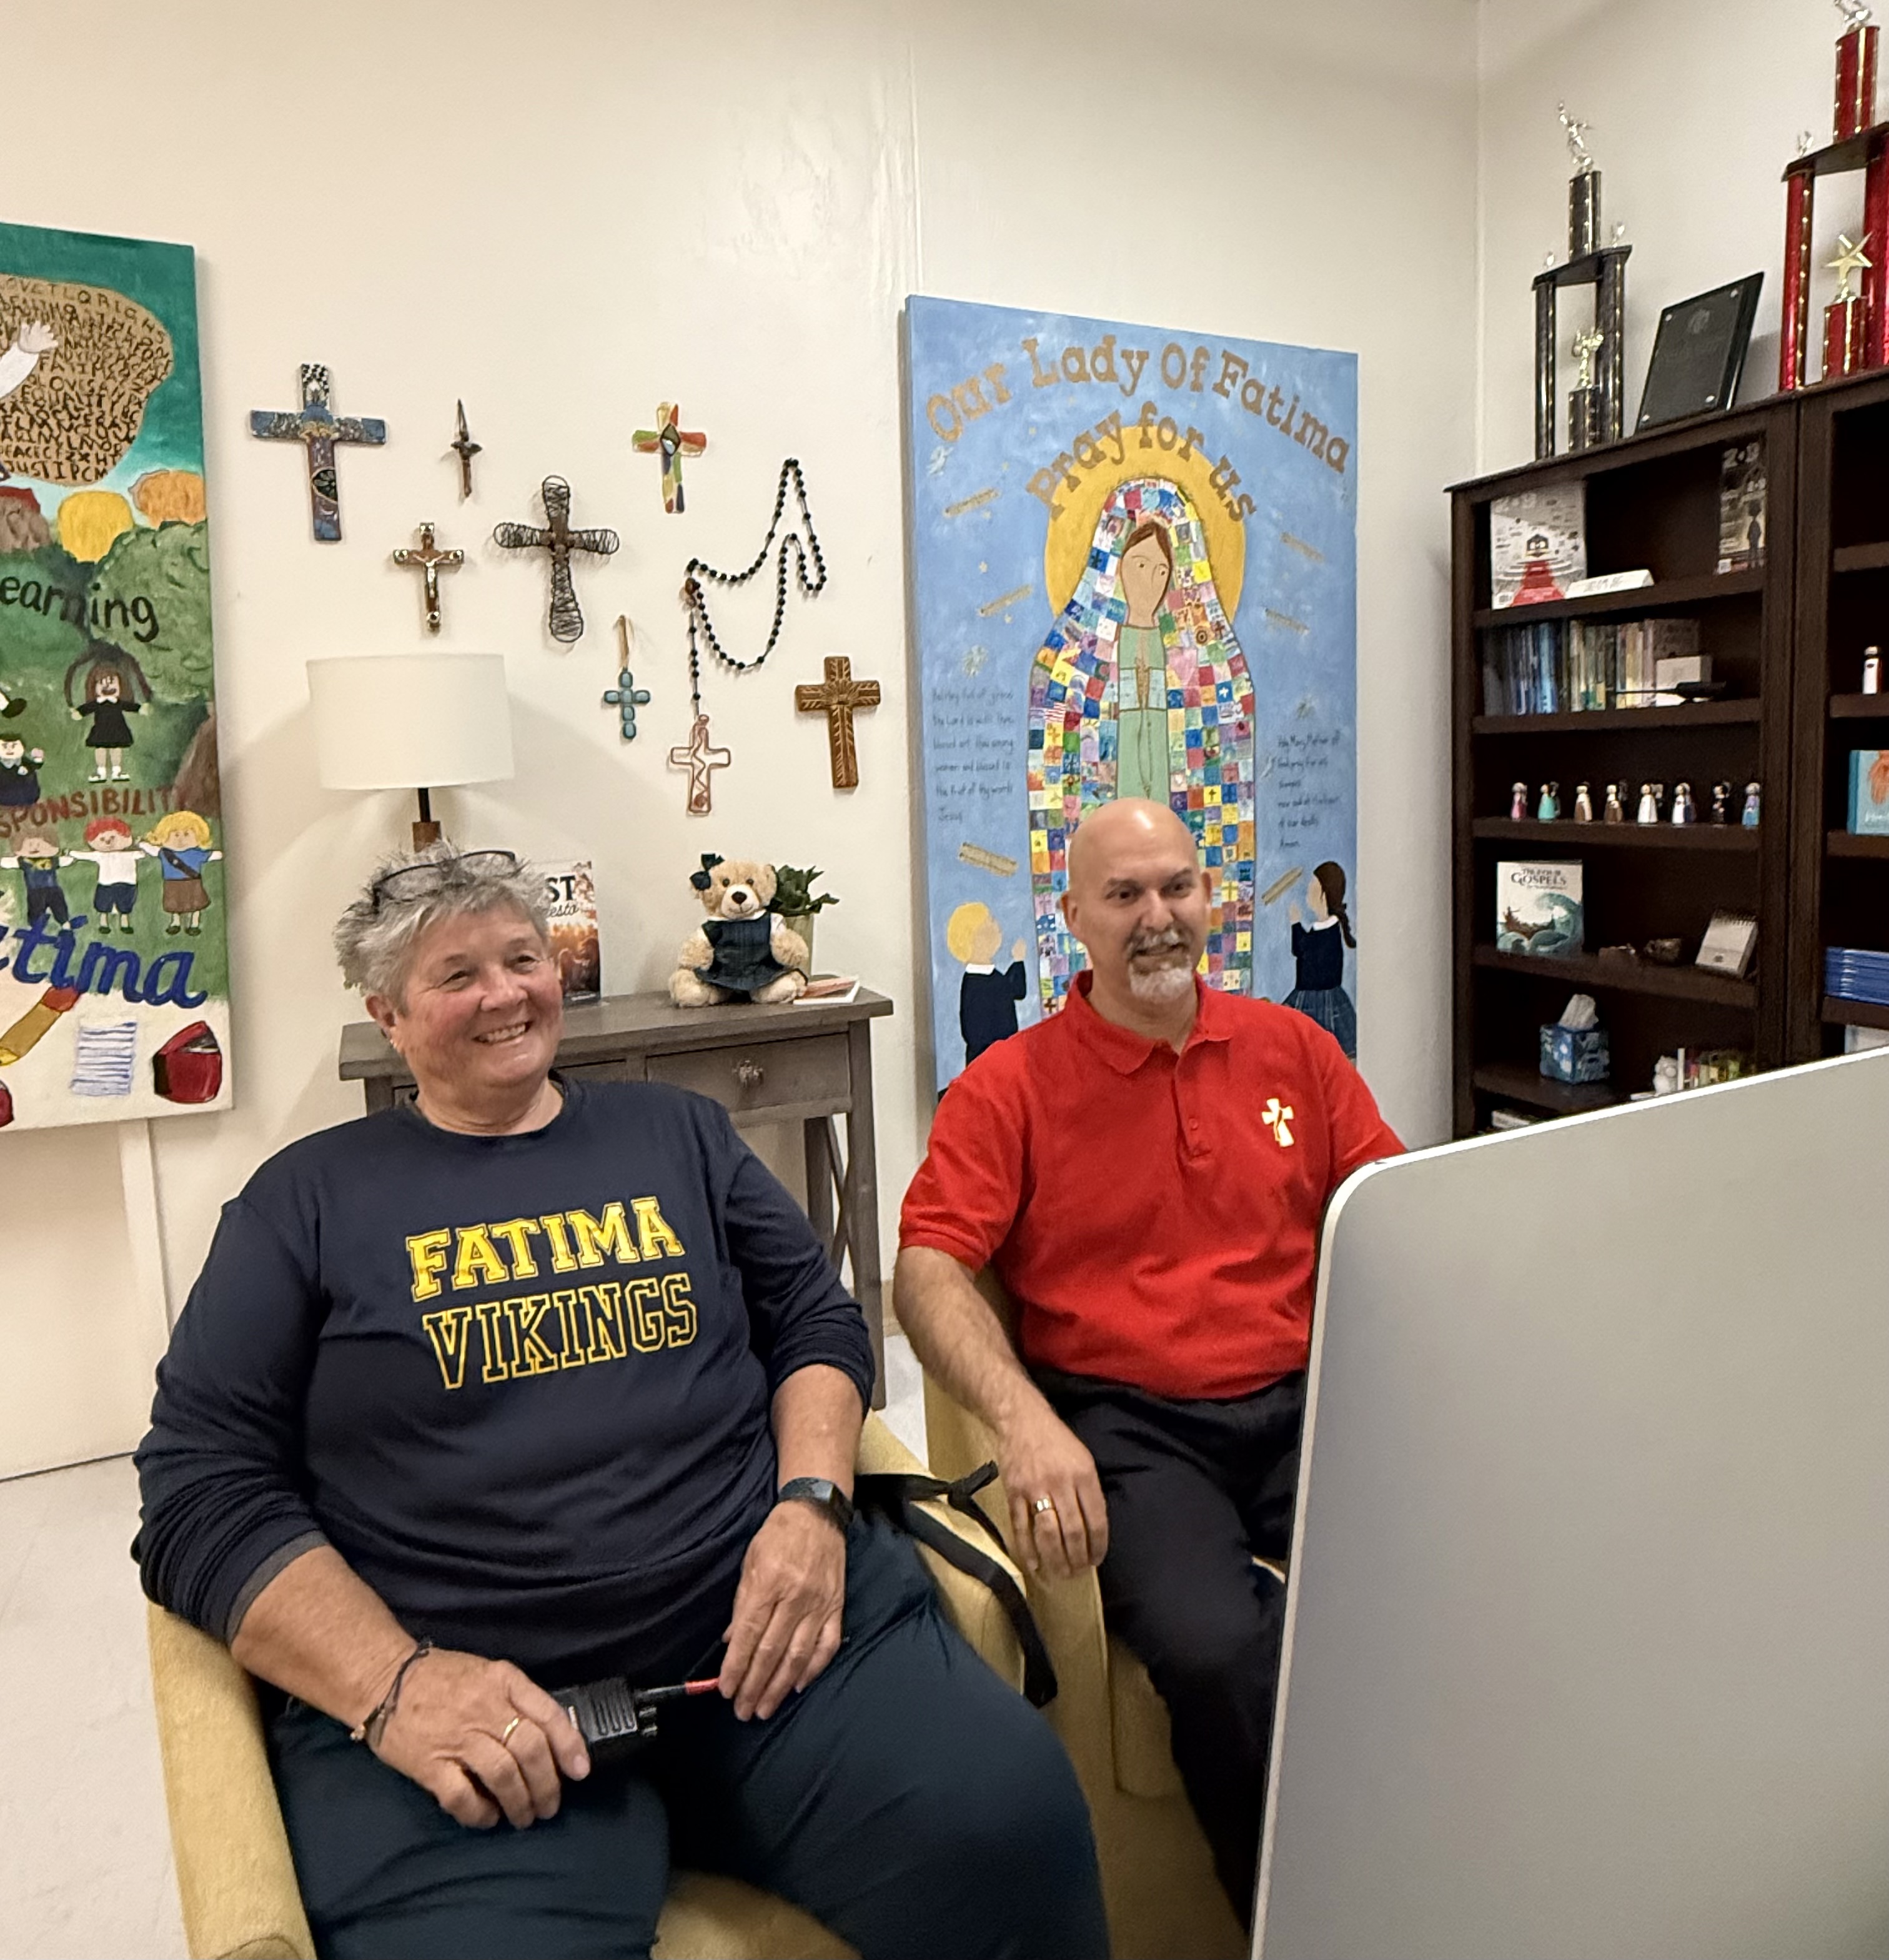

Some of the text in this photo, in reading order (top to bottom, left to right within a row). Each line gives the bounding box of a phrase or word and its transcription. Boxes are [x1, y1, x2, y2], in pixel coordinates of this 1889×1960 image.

[926, 335, 1351, 474] Our Lady Of Fatima
[1025, 400, 1257, 524] Pray for us
[0, 574, 159, 642] earning
[1510, 872, 1567, 886] GOSPELS
[405, 1195, 686, 1303] FATIMA
[422, 1272, 698, 1390] VIKINGS
